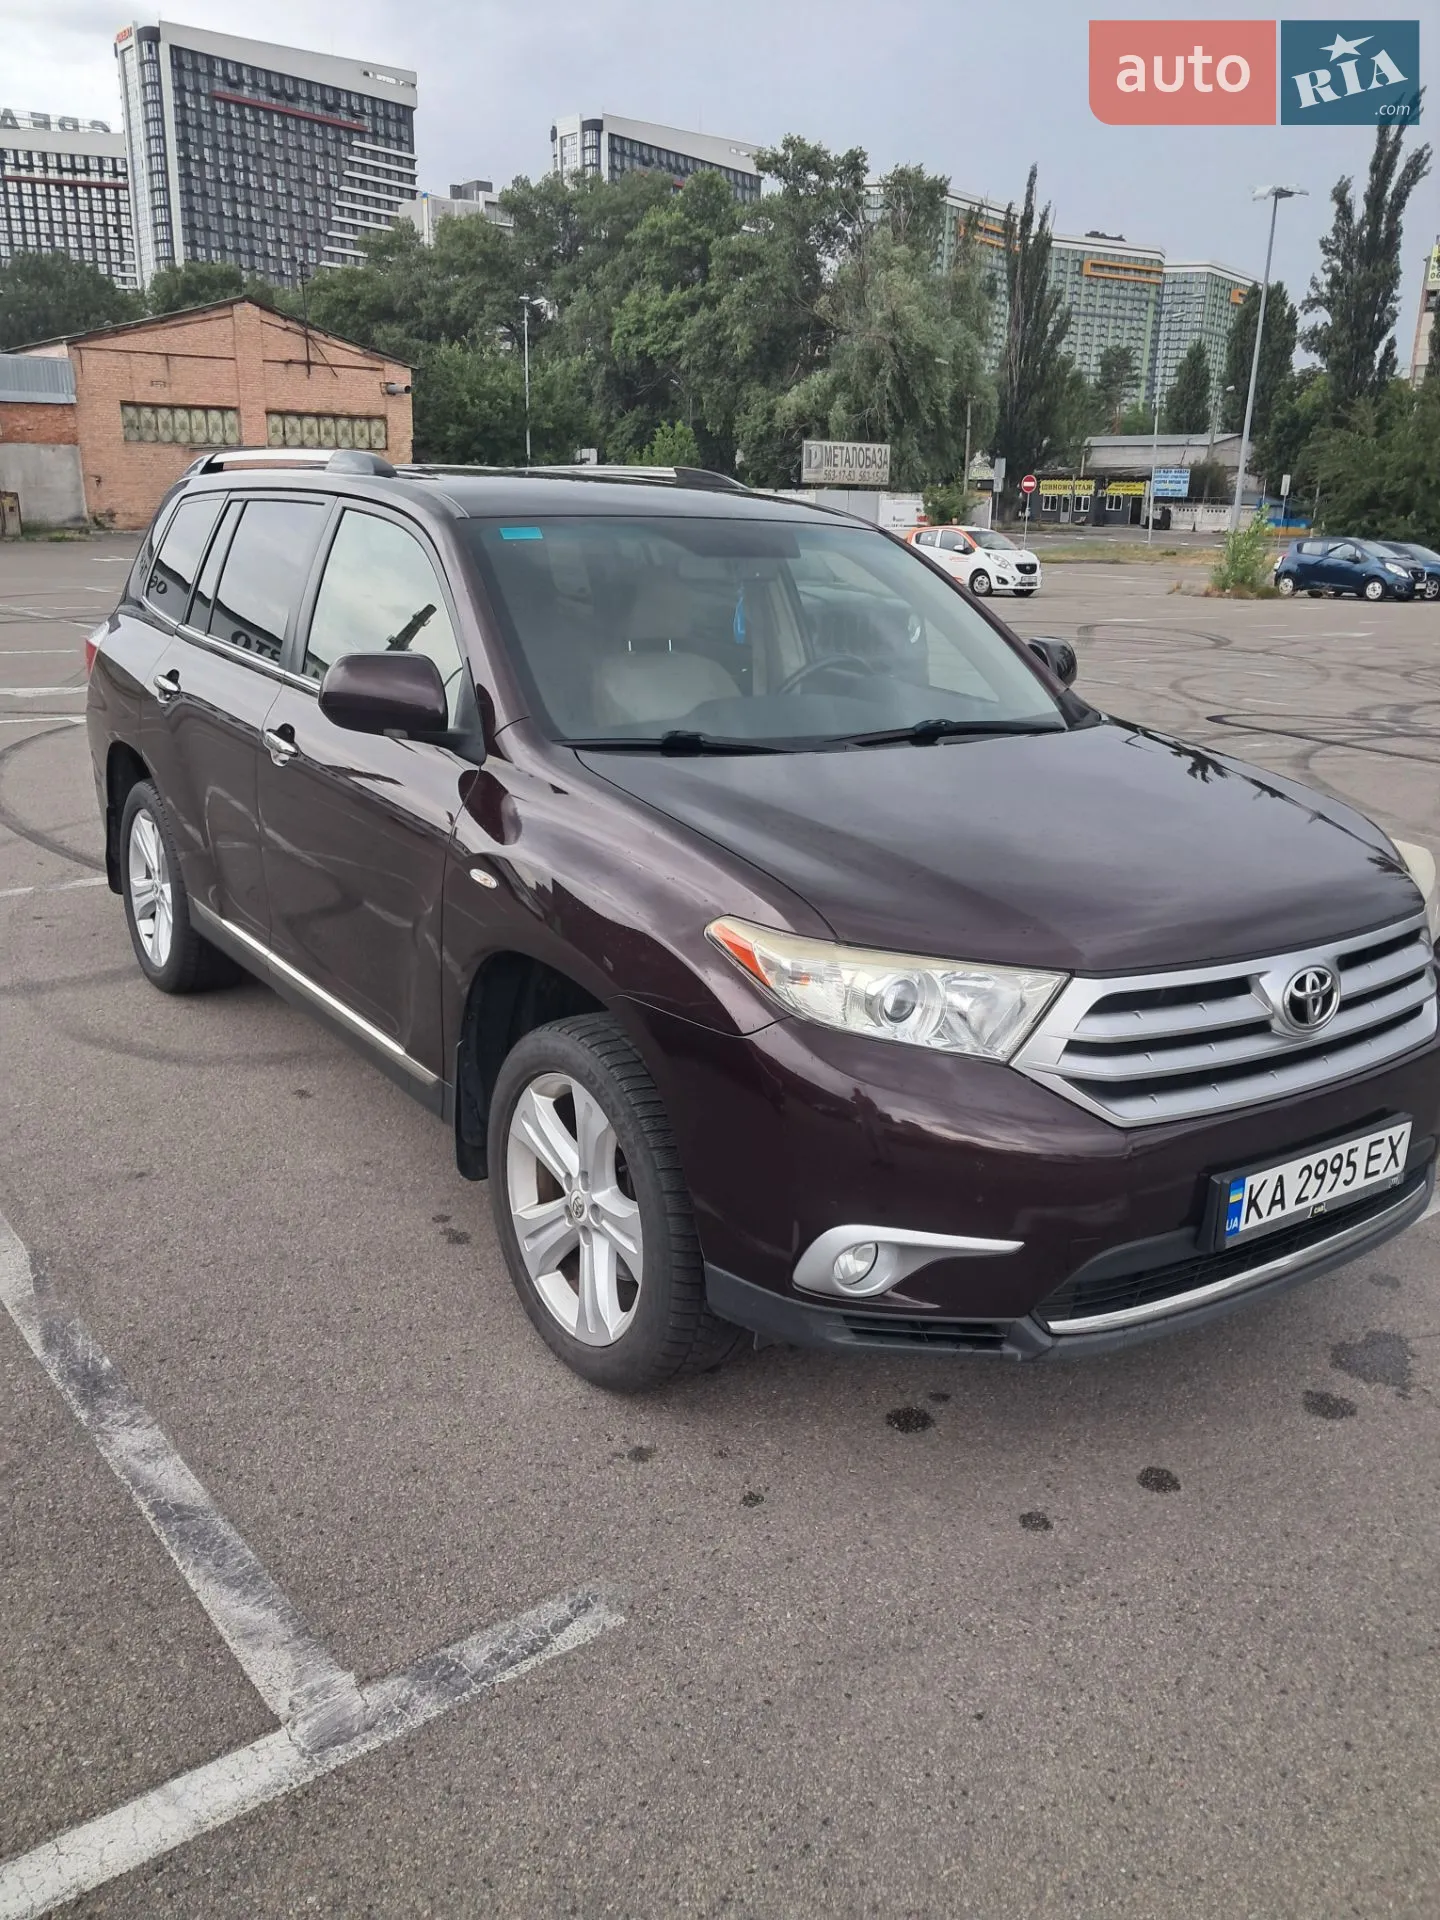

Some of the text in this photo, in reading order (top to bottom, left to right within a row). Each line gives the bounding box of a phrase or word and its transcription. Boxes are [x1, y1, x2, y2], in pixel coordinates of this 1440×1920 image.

[824, 445, 888, 470] МЕТАЛОБАЗА
[1245, 1131, 1405, 1225] KA 2995 EX
[1226, 1219, 1239, 1231] UA
